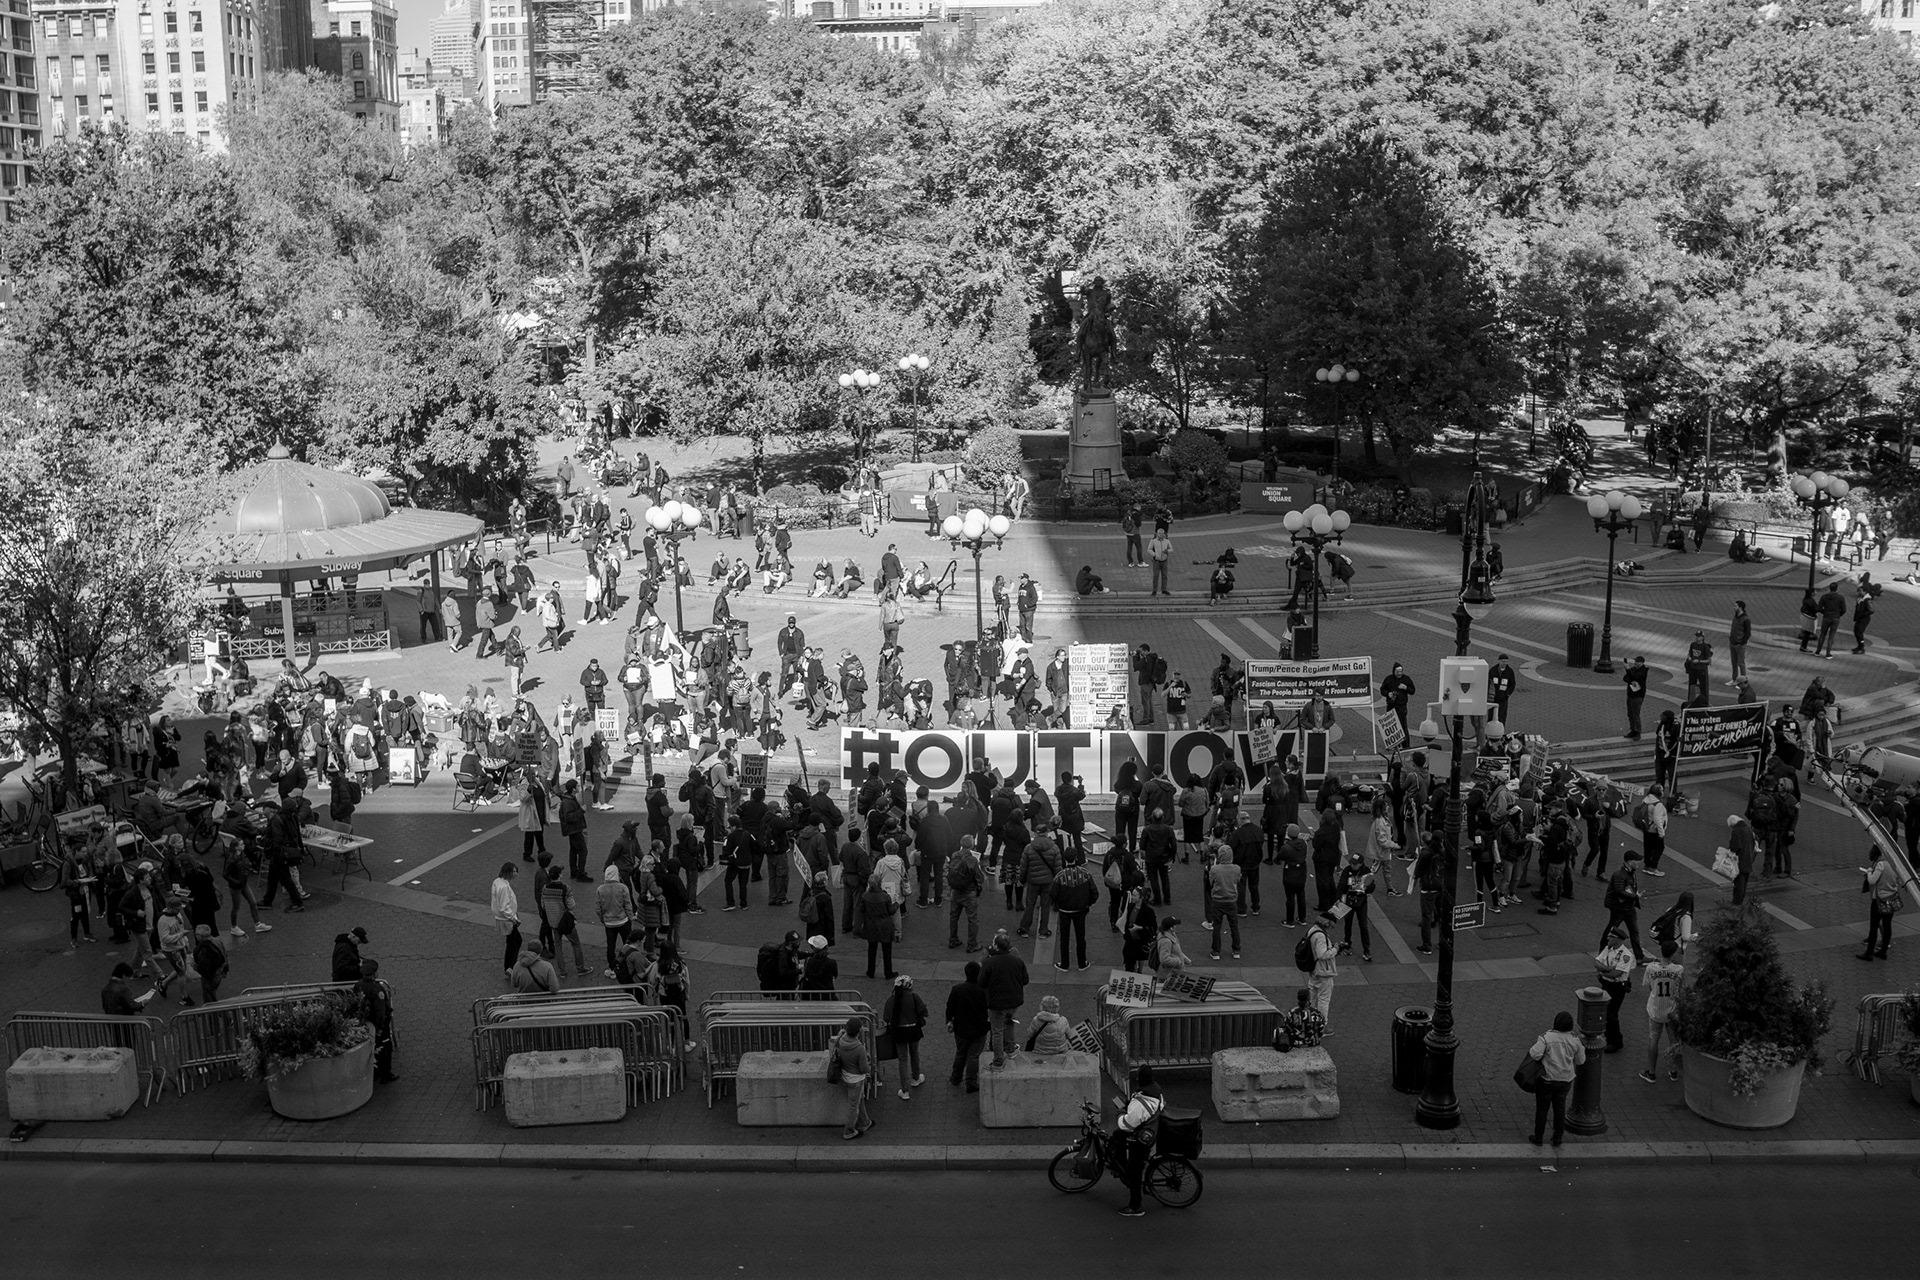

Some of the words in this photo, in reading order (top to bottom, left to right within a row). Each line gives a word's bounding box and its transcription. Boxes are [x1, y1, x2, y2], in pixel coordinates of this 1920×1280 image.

[321, 562, 363, 573] Subway
[264, 627, 286, 636] Subw
[1251, 664, 1300, 674] Trump/Pence
[1302, 665, 1330, 674] Regime
[1332, 662, 1351, 671] Must
[1353, 662, 1366, 670] Go!
[600, 721, 614, 729] OUT
[1260, 718, 1275, 727] NO!
[1381, 718, 1396, 729] Pence
[1700, 716, 1721, 724] system
[1384, 722, 1398, 737] OUT
[1385, 729, 1404, 747] NOW!
[1683, 744, 1692, 752] be
[1692, 722, 1761, 754] OVERTHROWN!
[1691, 733, 1710, 741] must
[1252, 739, 1272, 749] Streets
[1257, 751, 1272, 760] Stay!
[1532, 756, 1544, 768] OUT
[745, 767, 763, 775] OUT
[741, 775, 765, 784] NOW!
[1461, 905, 1480, 913] STOPPING
[1108, 978, 1118, 995] Take
[1119, 977, 1127, 990] the
[1162, 971, 1179, 992] Trump/
[1171, 974, 1185, 992] Pence
[1180, 976, 1196, 994] OUT
[1123, 976, 1135, 1003] Streets
[1133, 984, 1141, 998] and
[1139, 982, 1150, 1002] Stay!
[1189, 976, 1210, 1000] NOW!
[1658, 982, 1671, 997] 11
[1076, 1023, 1100, 1053] NOW!
